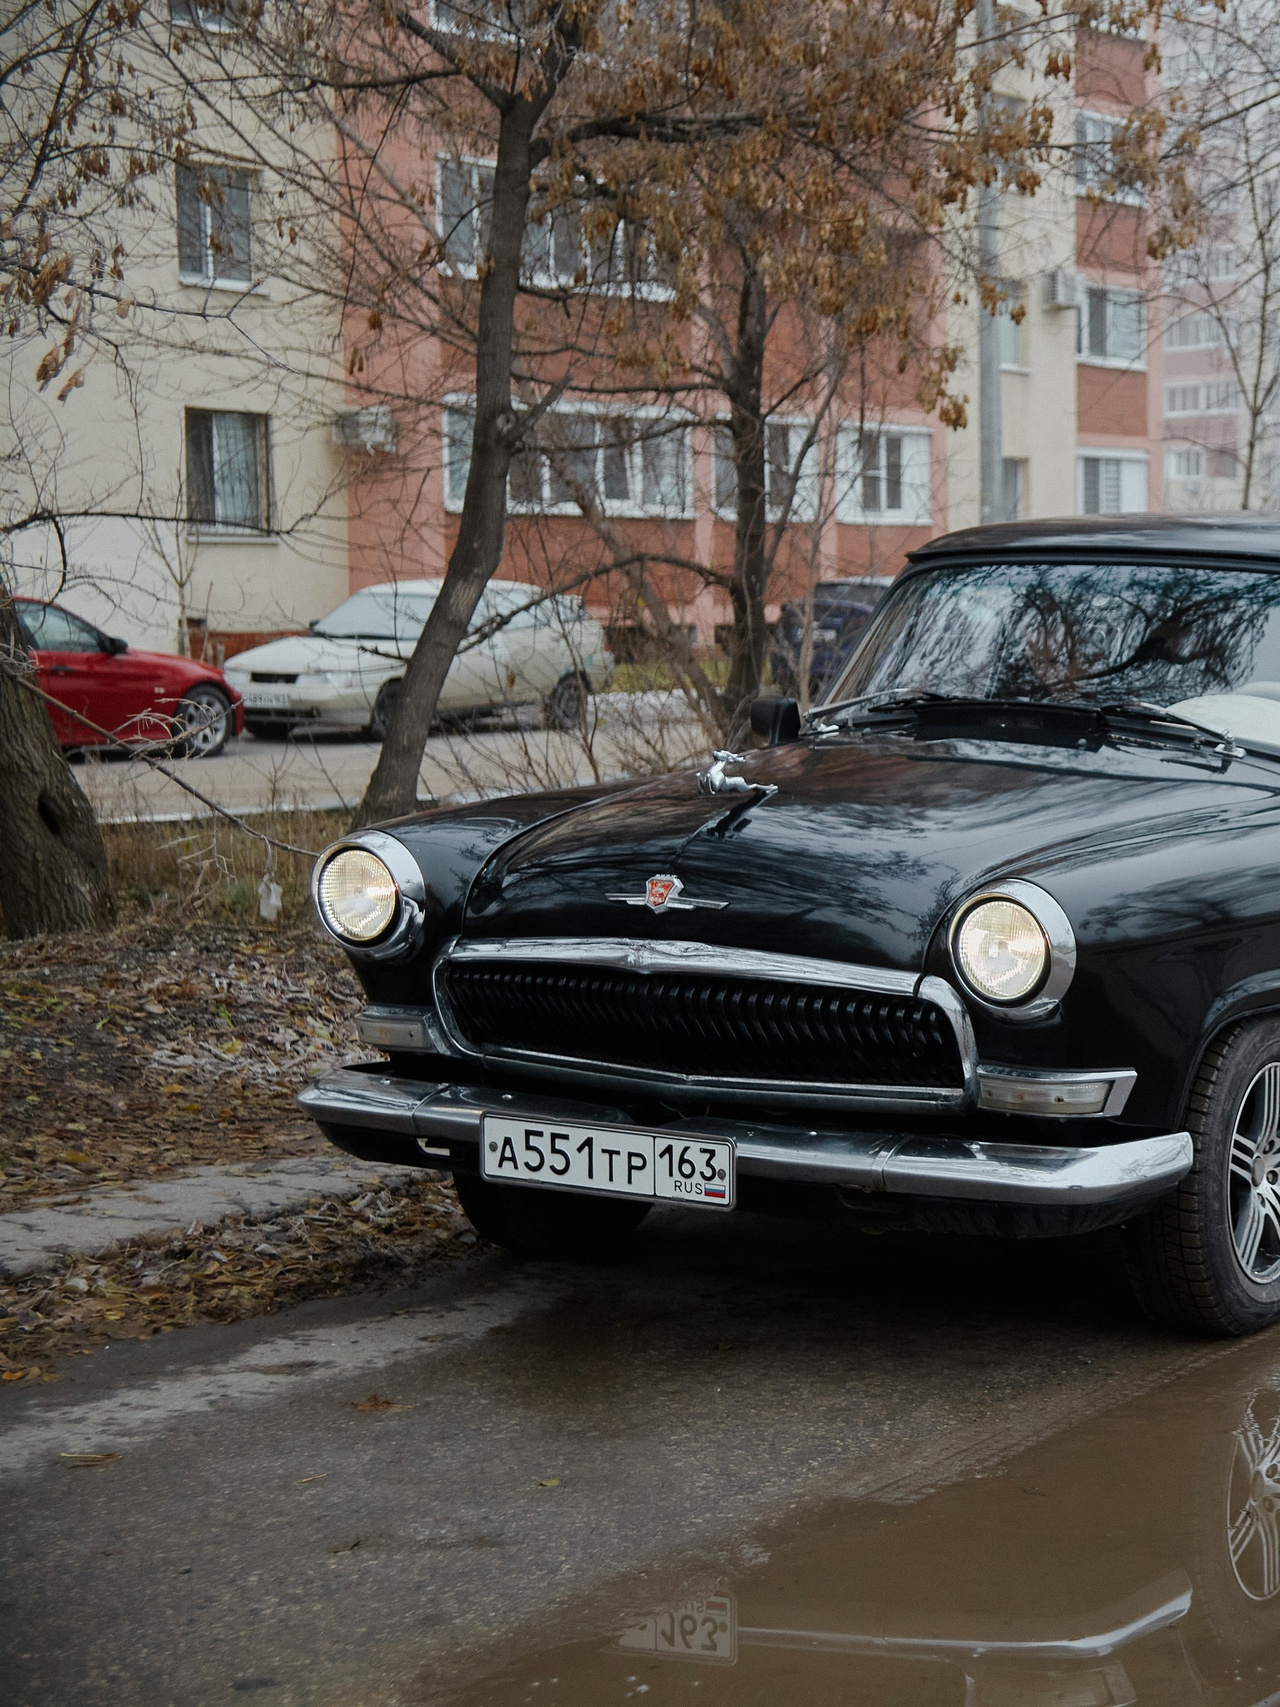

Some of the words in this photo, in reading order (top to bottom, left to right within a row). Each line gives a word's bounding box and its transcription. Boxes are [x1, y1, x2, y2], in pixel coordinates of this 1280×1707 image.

[497, 1129, 648, 1185] А551ТР
[658, 1143, 717, 1182] 163
[674, 1180, 703, 1195] RUS
